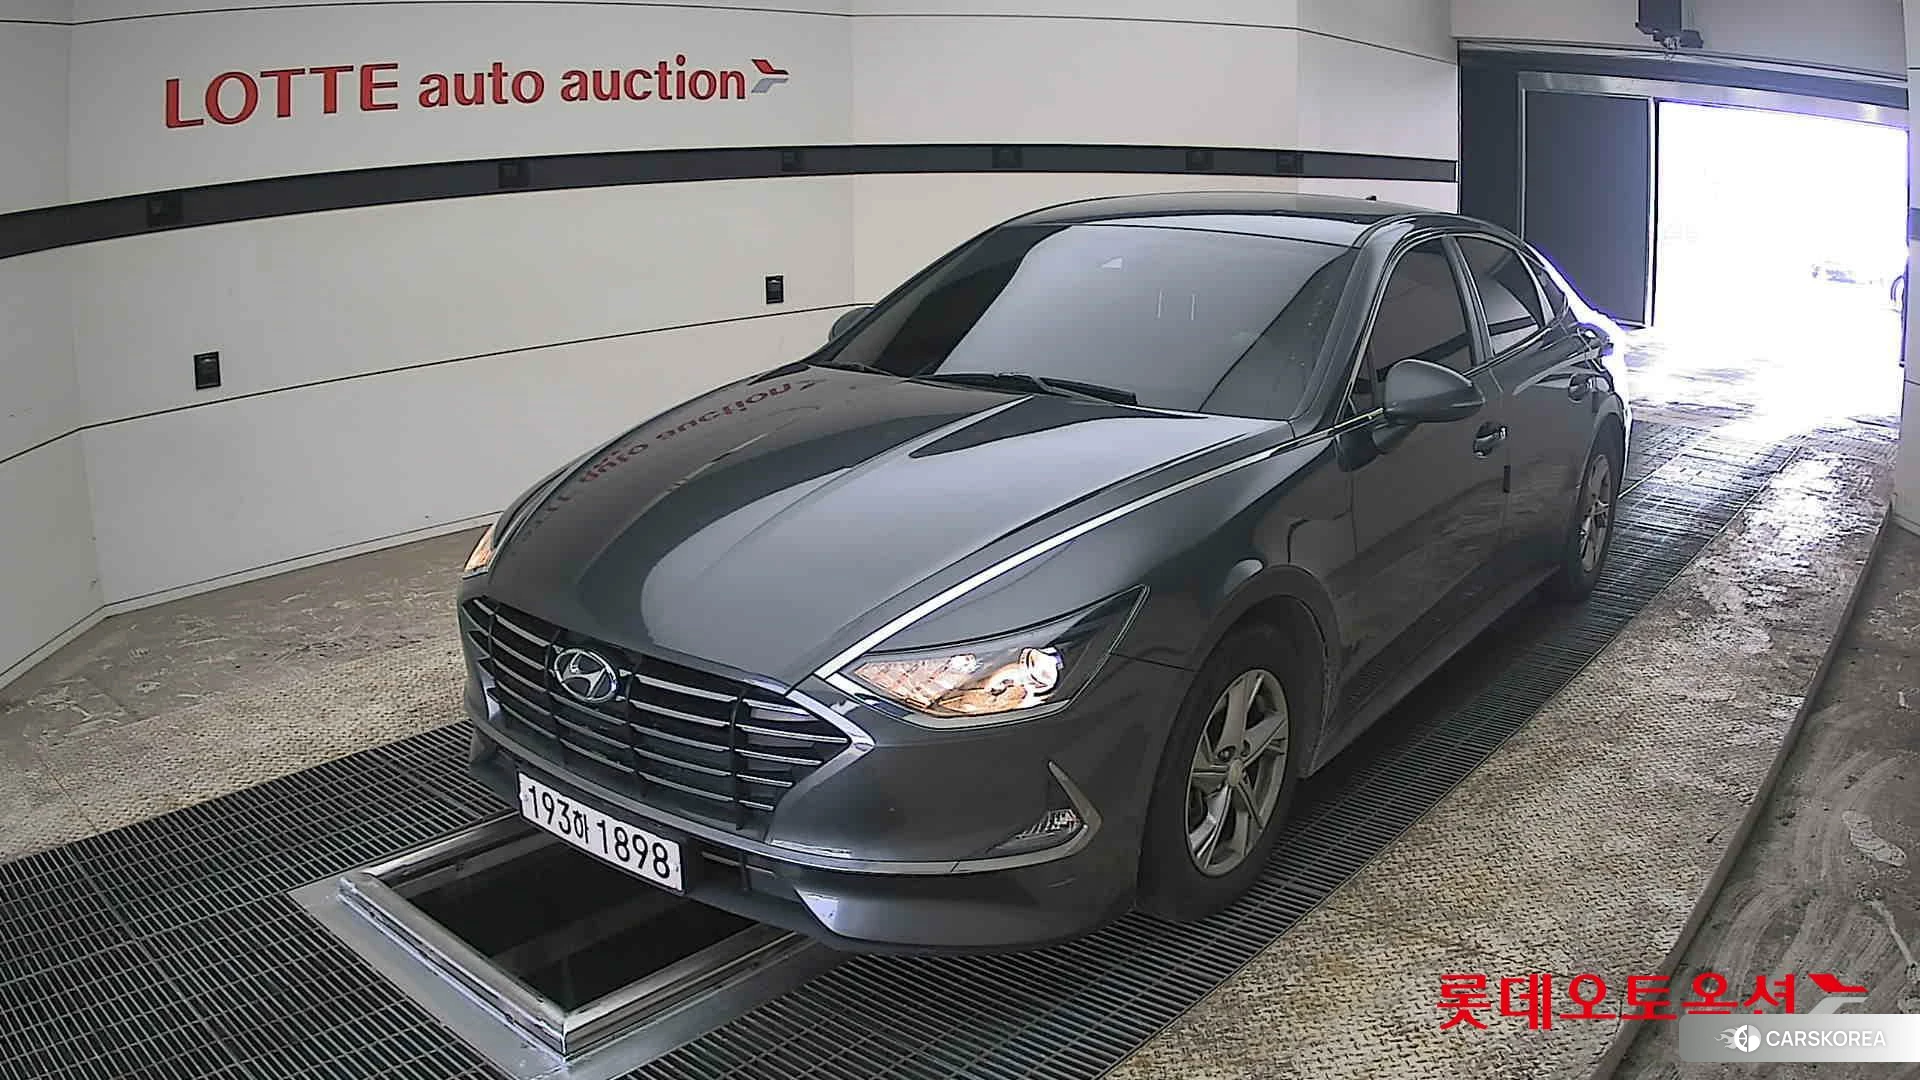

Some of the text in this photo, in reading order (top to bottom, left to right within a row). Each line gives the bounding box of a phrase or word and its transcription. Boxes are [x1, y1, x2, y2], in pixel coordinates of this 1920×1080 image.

[165, 54, 747, 129] LOTTE auto auction
[528, 785, 670, 879] 193하 1898
